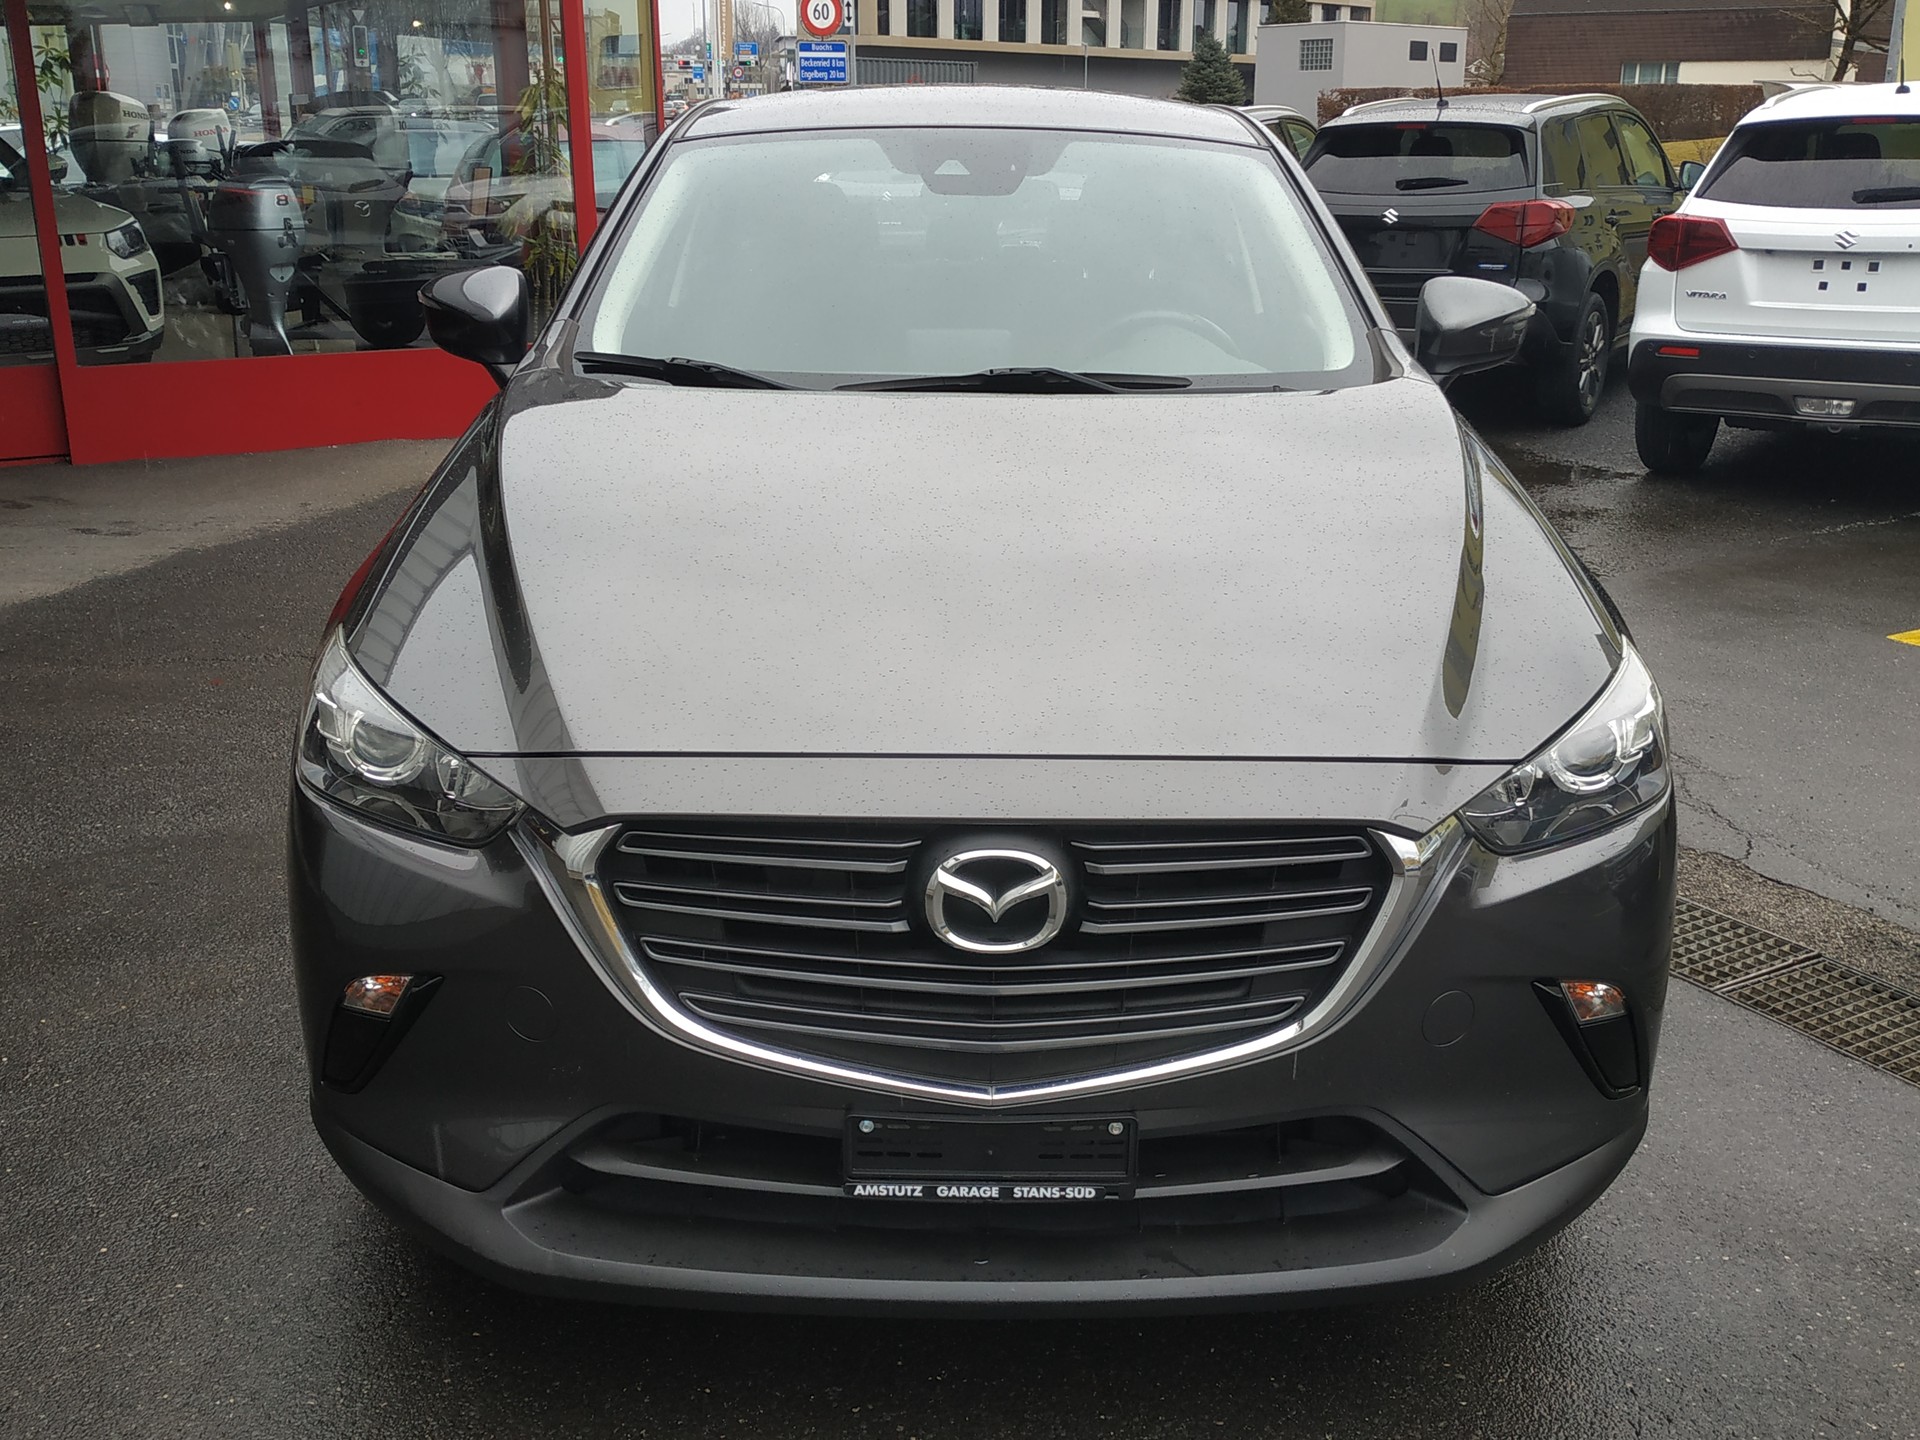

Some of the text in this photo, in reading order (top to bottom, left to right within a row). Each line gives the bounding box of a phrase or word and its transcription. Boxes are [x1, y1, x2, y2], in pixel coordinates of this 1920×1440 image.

[813, 3, 830, 20] 60
[811, 43, 833, 51] Buochs
[801, 59, 845, 67] Beckenried 8 km
[801, 70, 845, 80] Engelberg 20 km
[122, 109, 150, 120] HOND
[276, 194, 289, 206] 8
[1685, 291, 1727, 300] VITARA
[853, 1184, 1096, 1199] AMSTUTZ GARAGE STANS-SÜD
